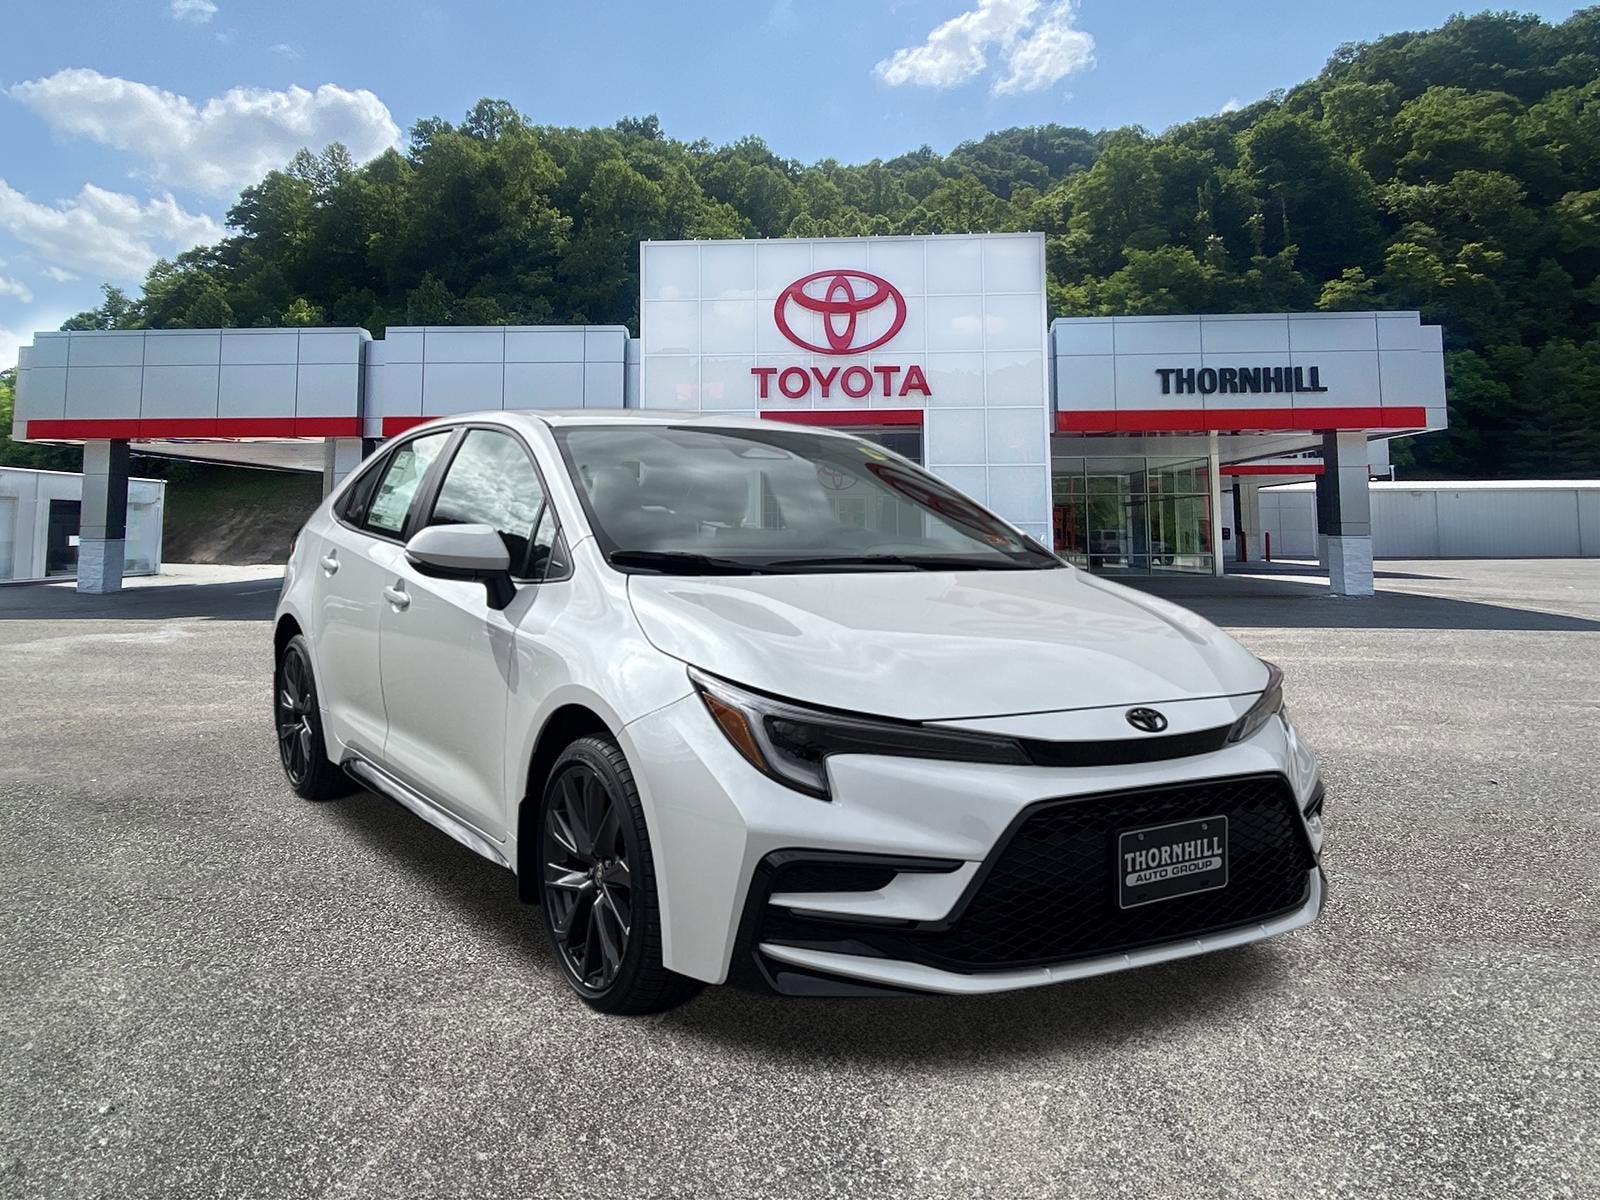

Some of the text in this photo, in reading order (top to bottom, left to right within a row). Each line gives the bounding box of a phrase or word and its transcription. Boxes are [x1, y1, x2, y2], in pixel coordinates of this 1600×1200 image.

[751, 365, 932, 399] TOYOTA
[1156, 366, 1328, 394] THORNHILL
[1124, 836, 1223, 872] THORNHILL
[1135, 860, 1213, 883] AUTO GROUP
